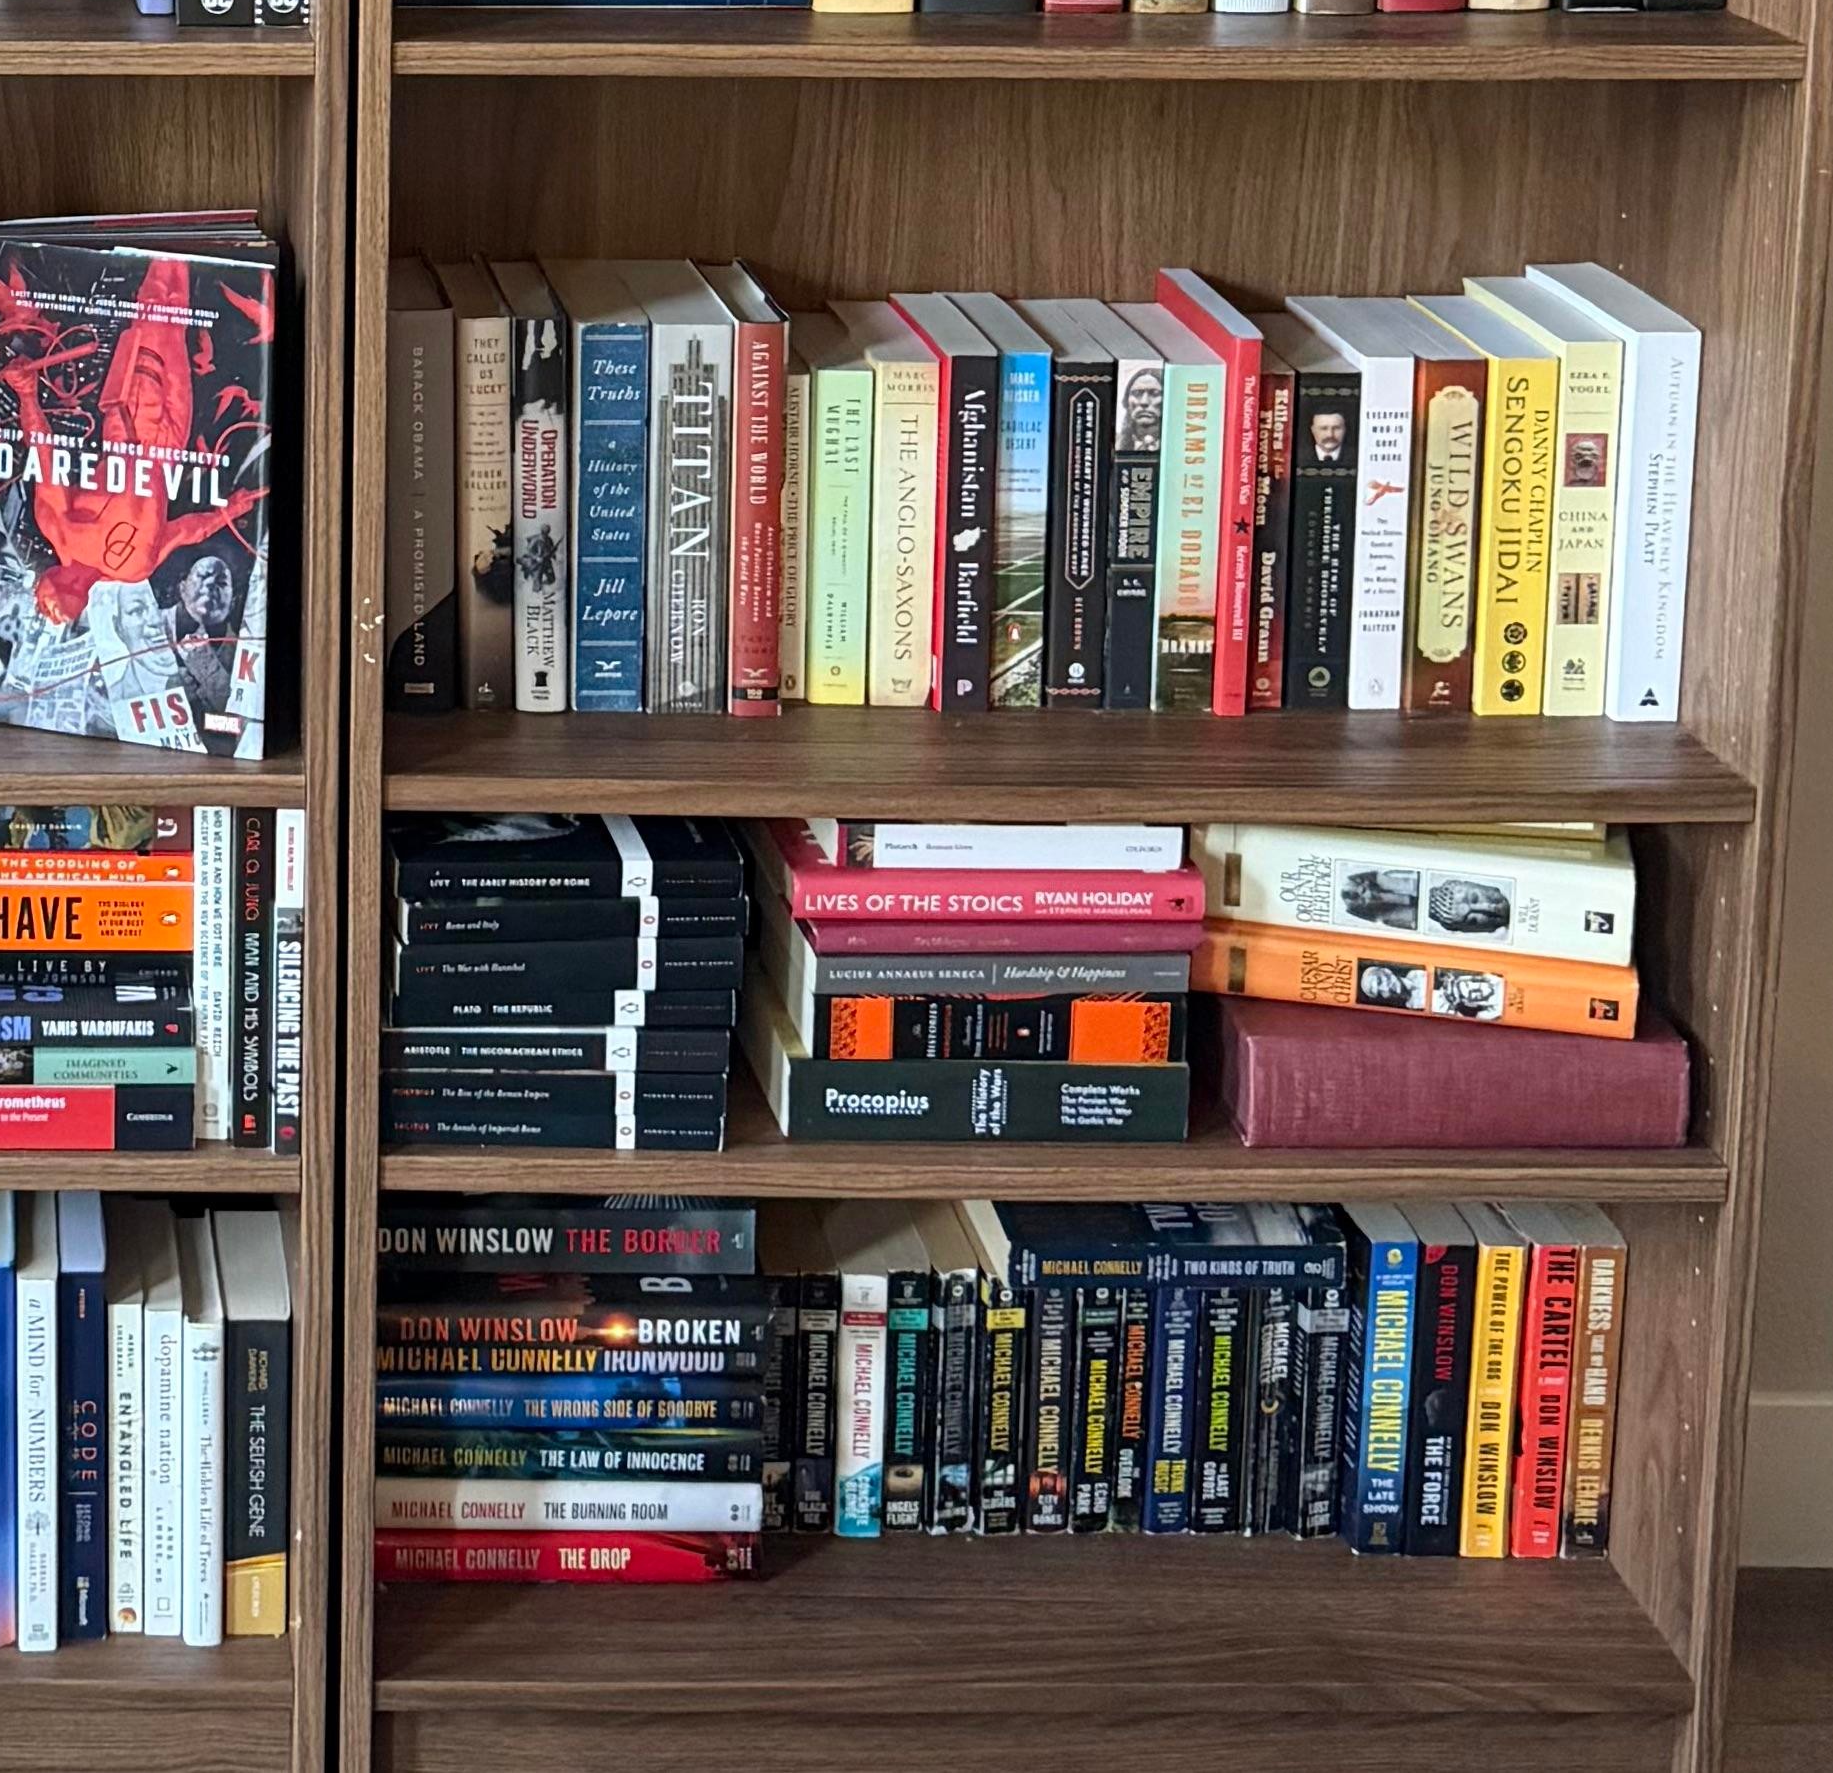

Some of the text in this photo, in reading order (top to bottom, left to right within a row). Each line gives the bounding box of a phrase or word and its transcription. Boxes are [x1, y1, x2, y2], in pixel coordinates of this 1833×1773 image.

[593, 359, 637, 377] These
[587, 385, 641, 403] Truths
[959, 389, 987, 518] Afghanistan
[670, 382, 713, 562] TITAN
[1496, 377, 1528, 604] SENGOKU JIDAI
[594, 578, 625, 597] Jill
[582, 603, 638, 625] Lepore
[805, 893, 1022, 912] LIVES OF THE STOICS
[825, 1089, 929, 1112] Procopius
[378, 1228, 720, 1254] DON WINSLOW THE BORDER
[1042, 1259, 1143, 1276] MICHAEL CONNELLY
[1245, 1260, 1258, 1275] OF
[1262, 1260, 1295, 1276] TRUTH
[638, 1320, 740, 1344] BROKEN
[249, 1406, 266, 1538] THE SELFISH GENE
